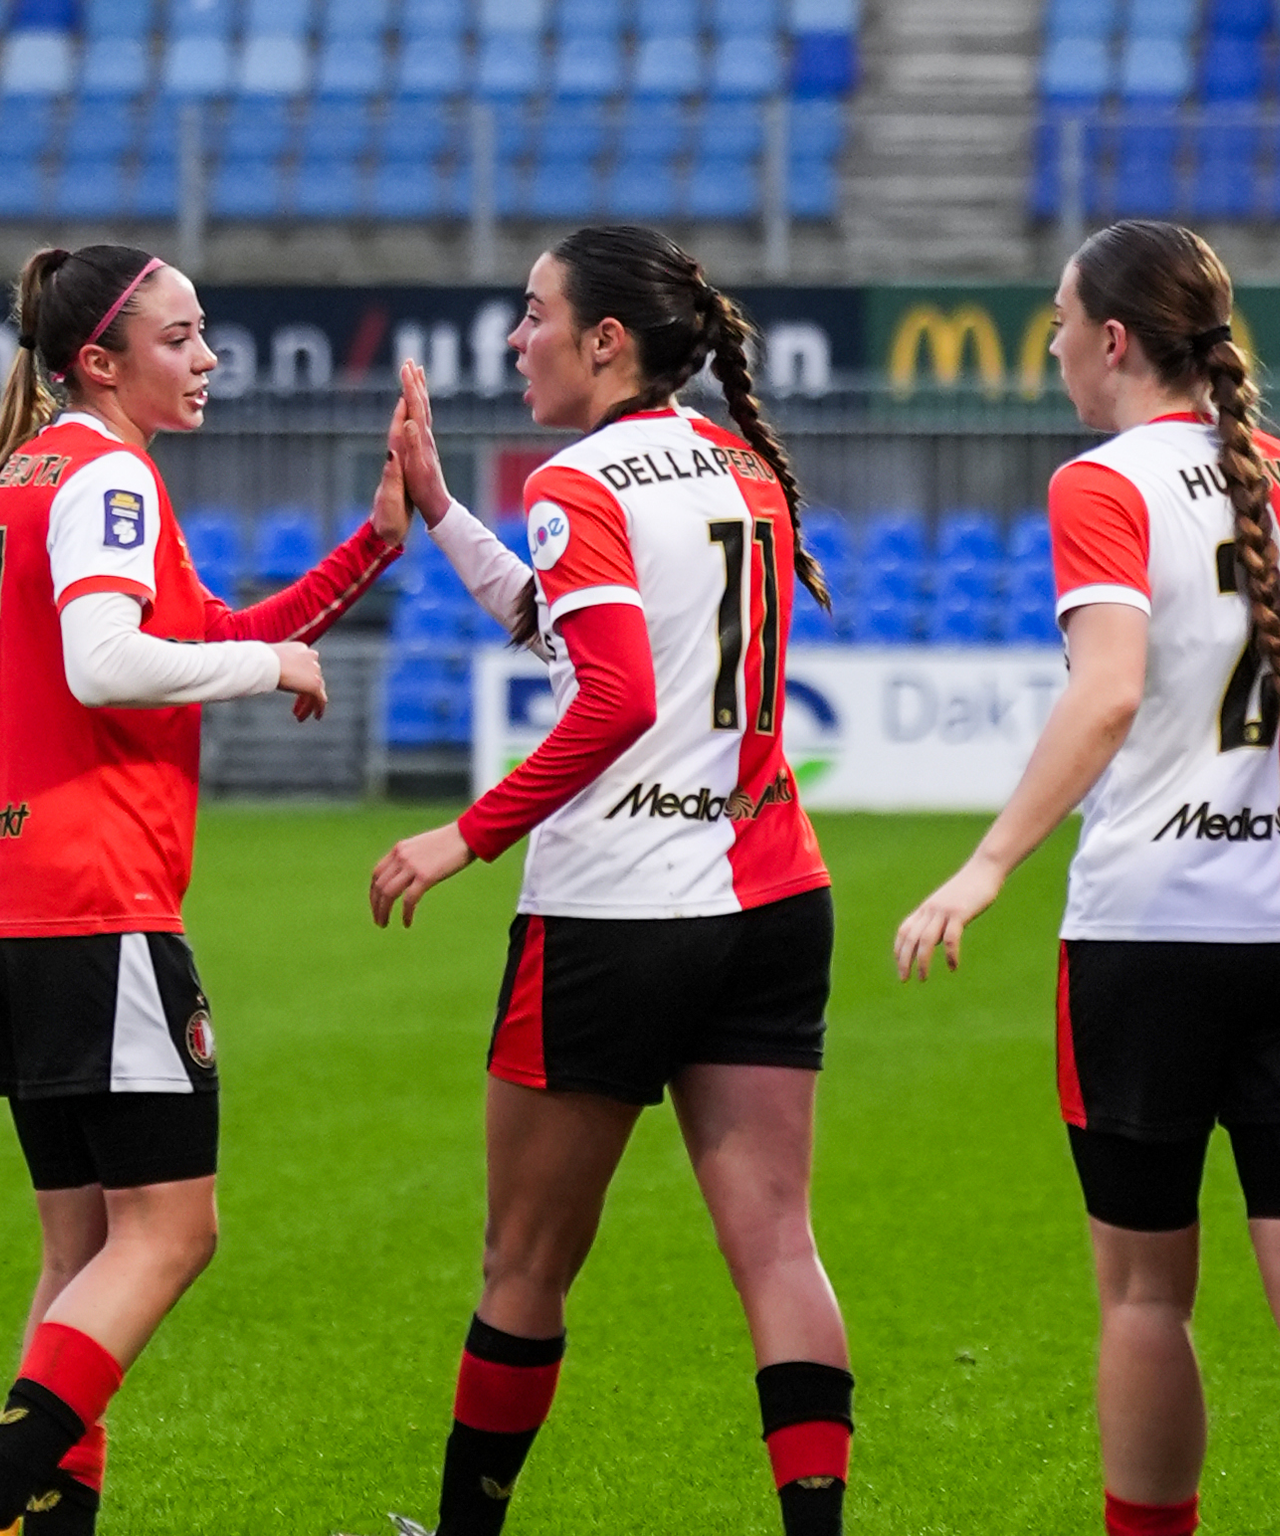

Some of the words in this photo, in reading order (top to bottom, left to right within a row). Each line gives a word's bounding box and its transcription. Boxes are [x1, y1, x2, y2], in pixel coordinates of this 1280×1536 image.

[599, 446, 777, 491] DELLAPERU
[705, 517, 775, 738] 11
[604, 782, 727, 824] Media
[1150, 801, 1272, 842] Media
